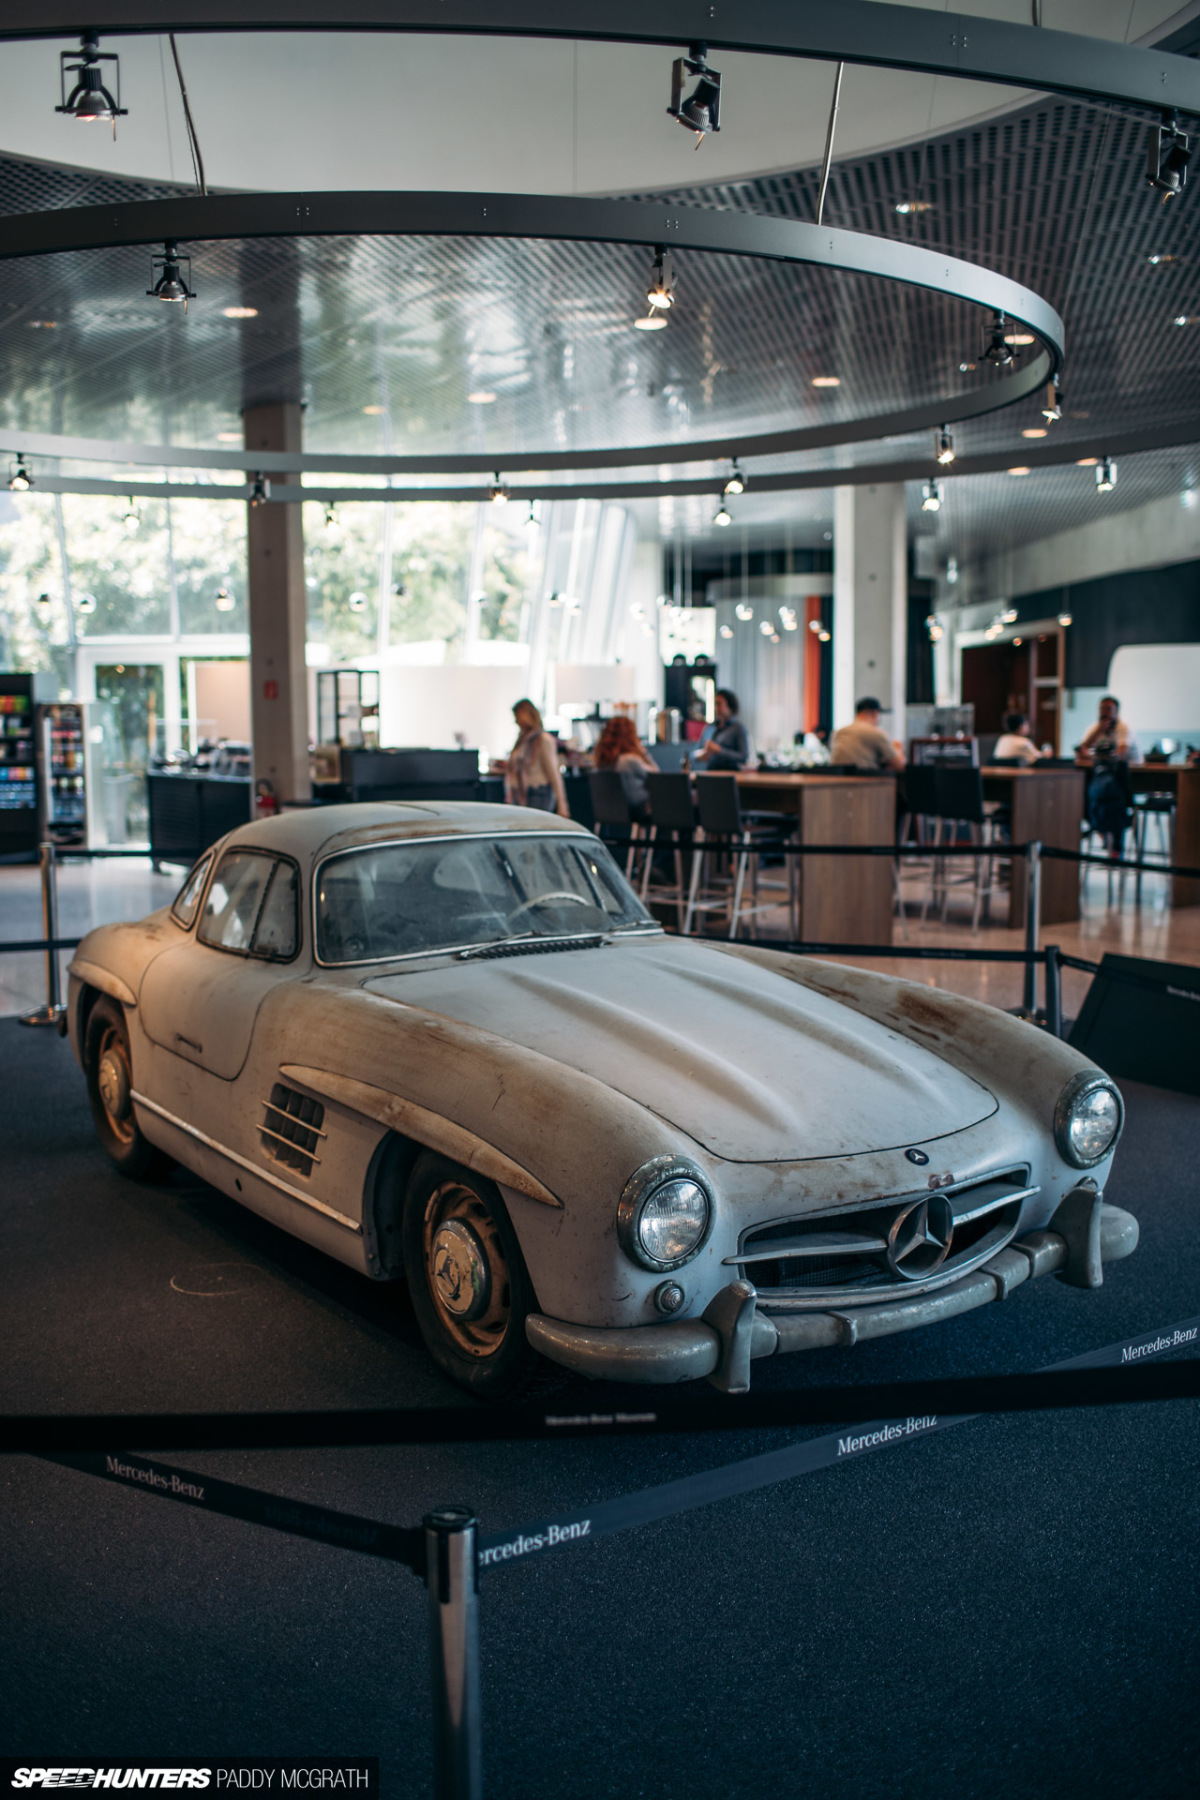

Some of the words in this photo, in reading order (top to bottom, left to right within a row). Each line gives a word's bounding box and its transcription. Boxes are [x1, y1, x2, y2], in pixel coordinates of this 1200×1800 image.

[1121, 1327, 1198, 1363] Mercedes-Benz
[837, 1414, 938, 1456] Mercedes-Benz
[106, 1455, 205, 1500] Mercedes-Benz
[478, 1519, 592, 1566] rcedes-Benz
